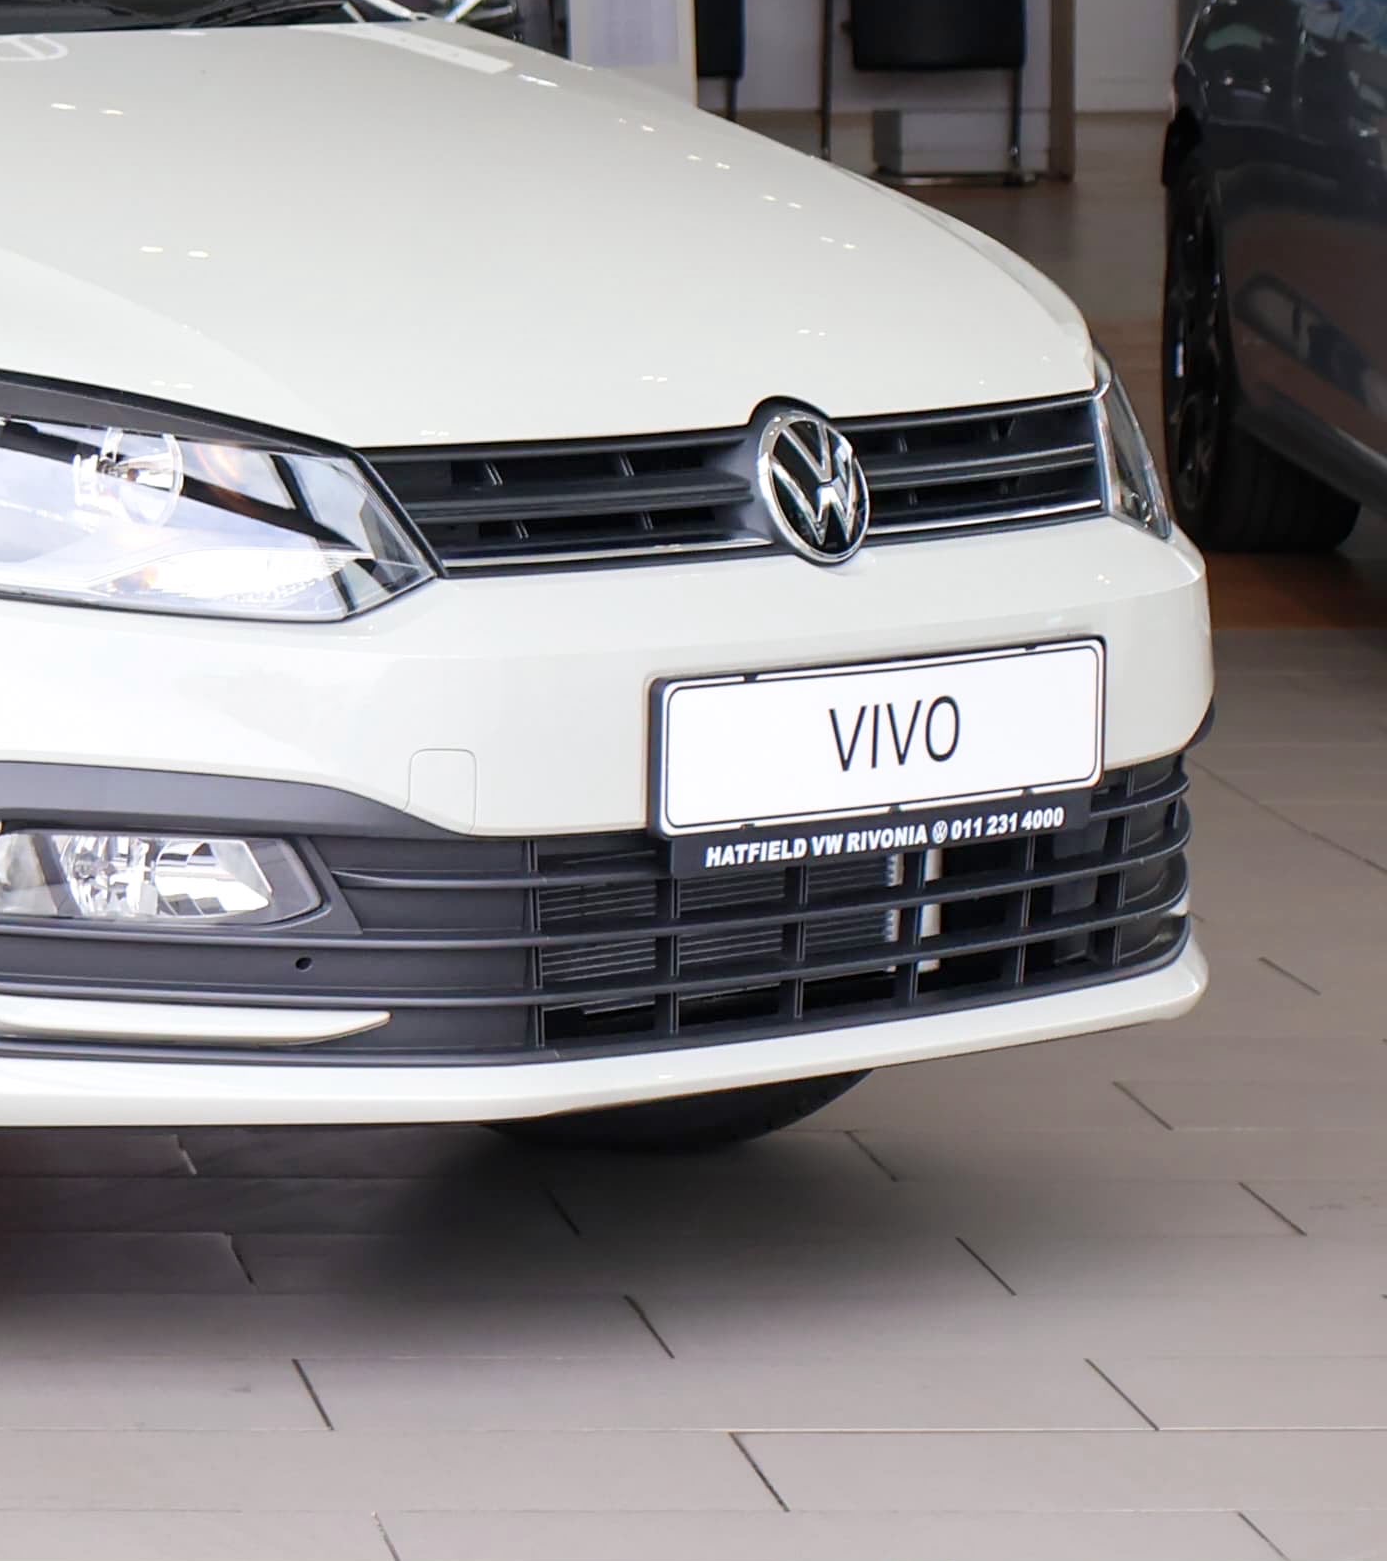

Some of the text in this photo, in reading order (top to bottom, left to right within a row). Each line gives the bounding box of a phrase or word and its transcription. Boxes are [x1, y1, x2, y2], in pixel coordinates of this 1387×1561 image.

[829, 695, 960, 772] VIVO
[705, 838, 808, 868] HATFIELD
[811, 833, 844, 857] VW
[846, 824, 929, 853] RIVONIA
[950, 817, 983, 841] 011
[985, 812, 1019, 836] 231
[1020, 806, 1065, 831] 4000
